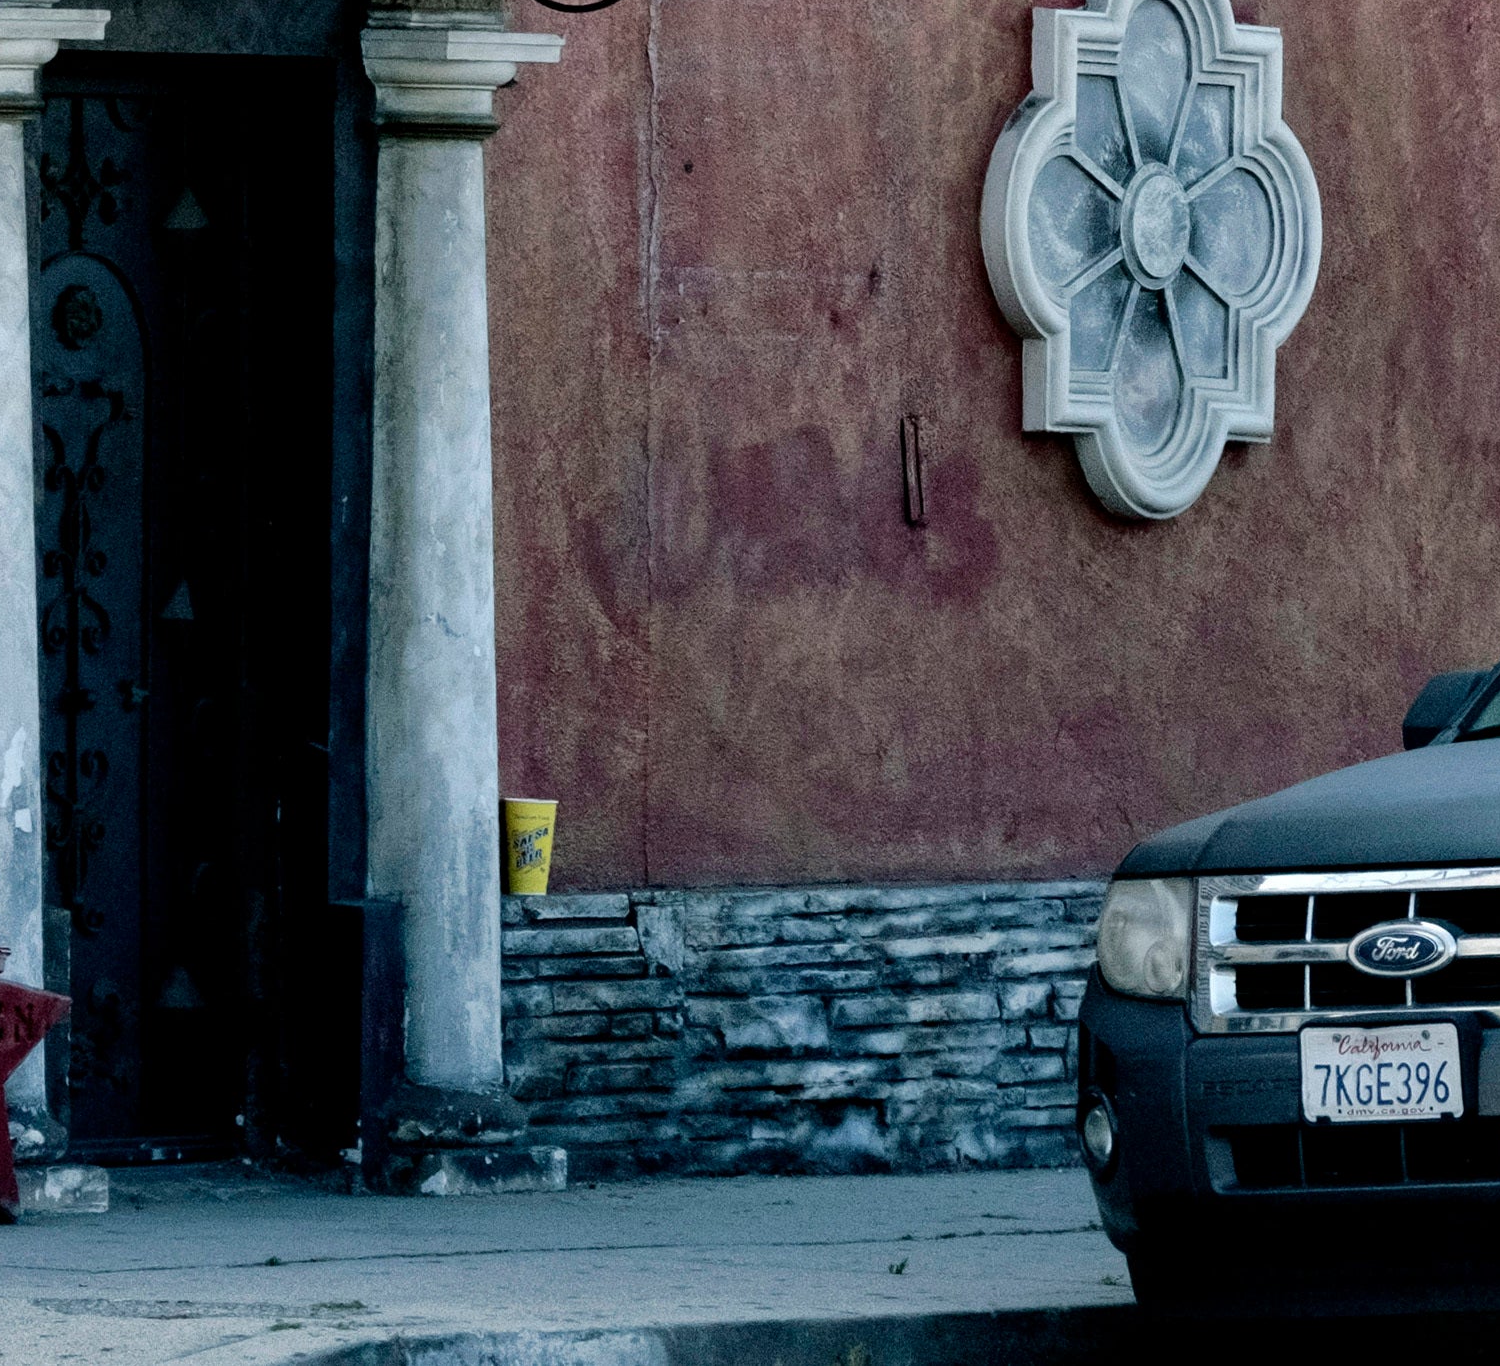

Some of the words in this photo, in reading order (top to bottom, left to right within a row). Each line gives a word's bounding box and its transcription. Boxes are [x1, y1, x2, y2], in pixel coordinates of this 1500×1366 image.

[1371, 936, 1421, 961] Ford
[1339, 1035, 1431, 1060] California
[1314, 1061, 1449, 1107] 7KGE396
[1347, 1106, 1425, 1116] dmv.ca.gov
